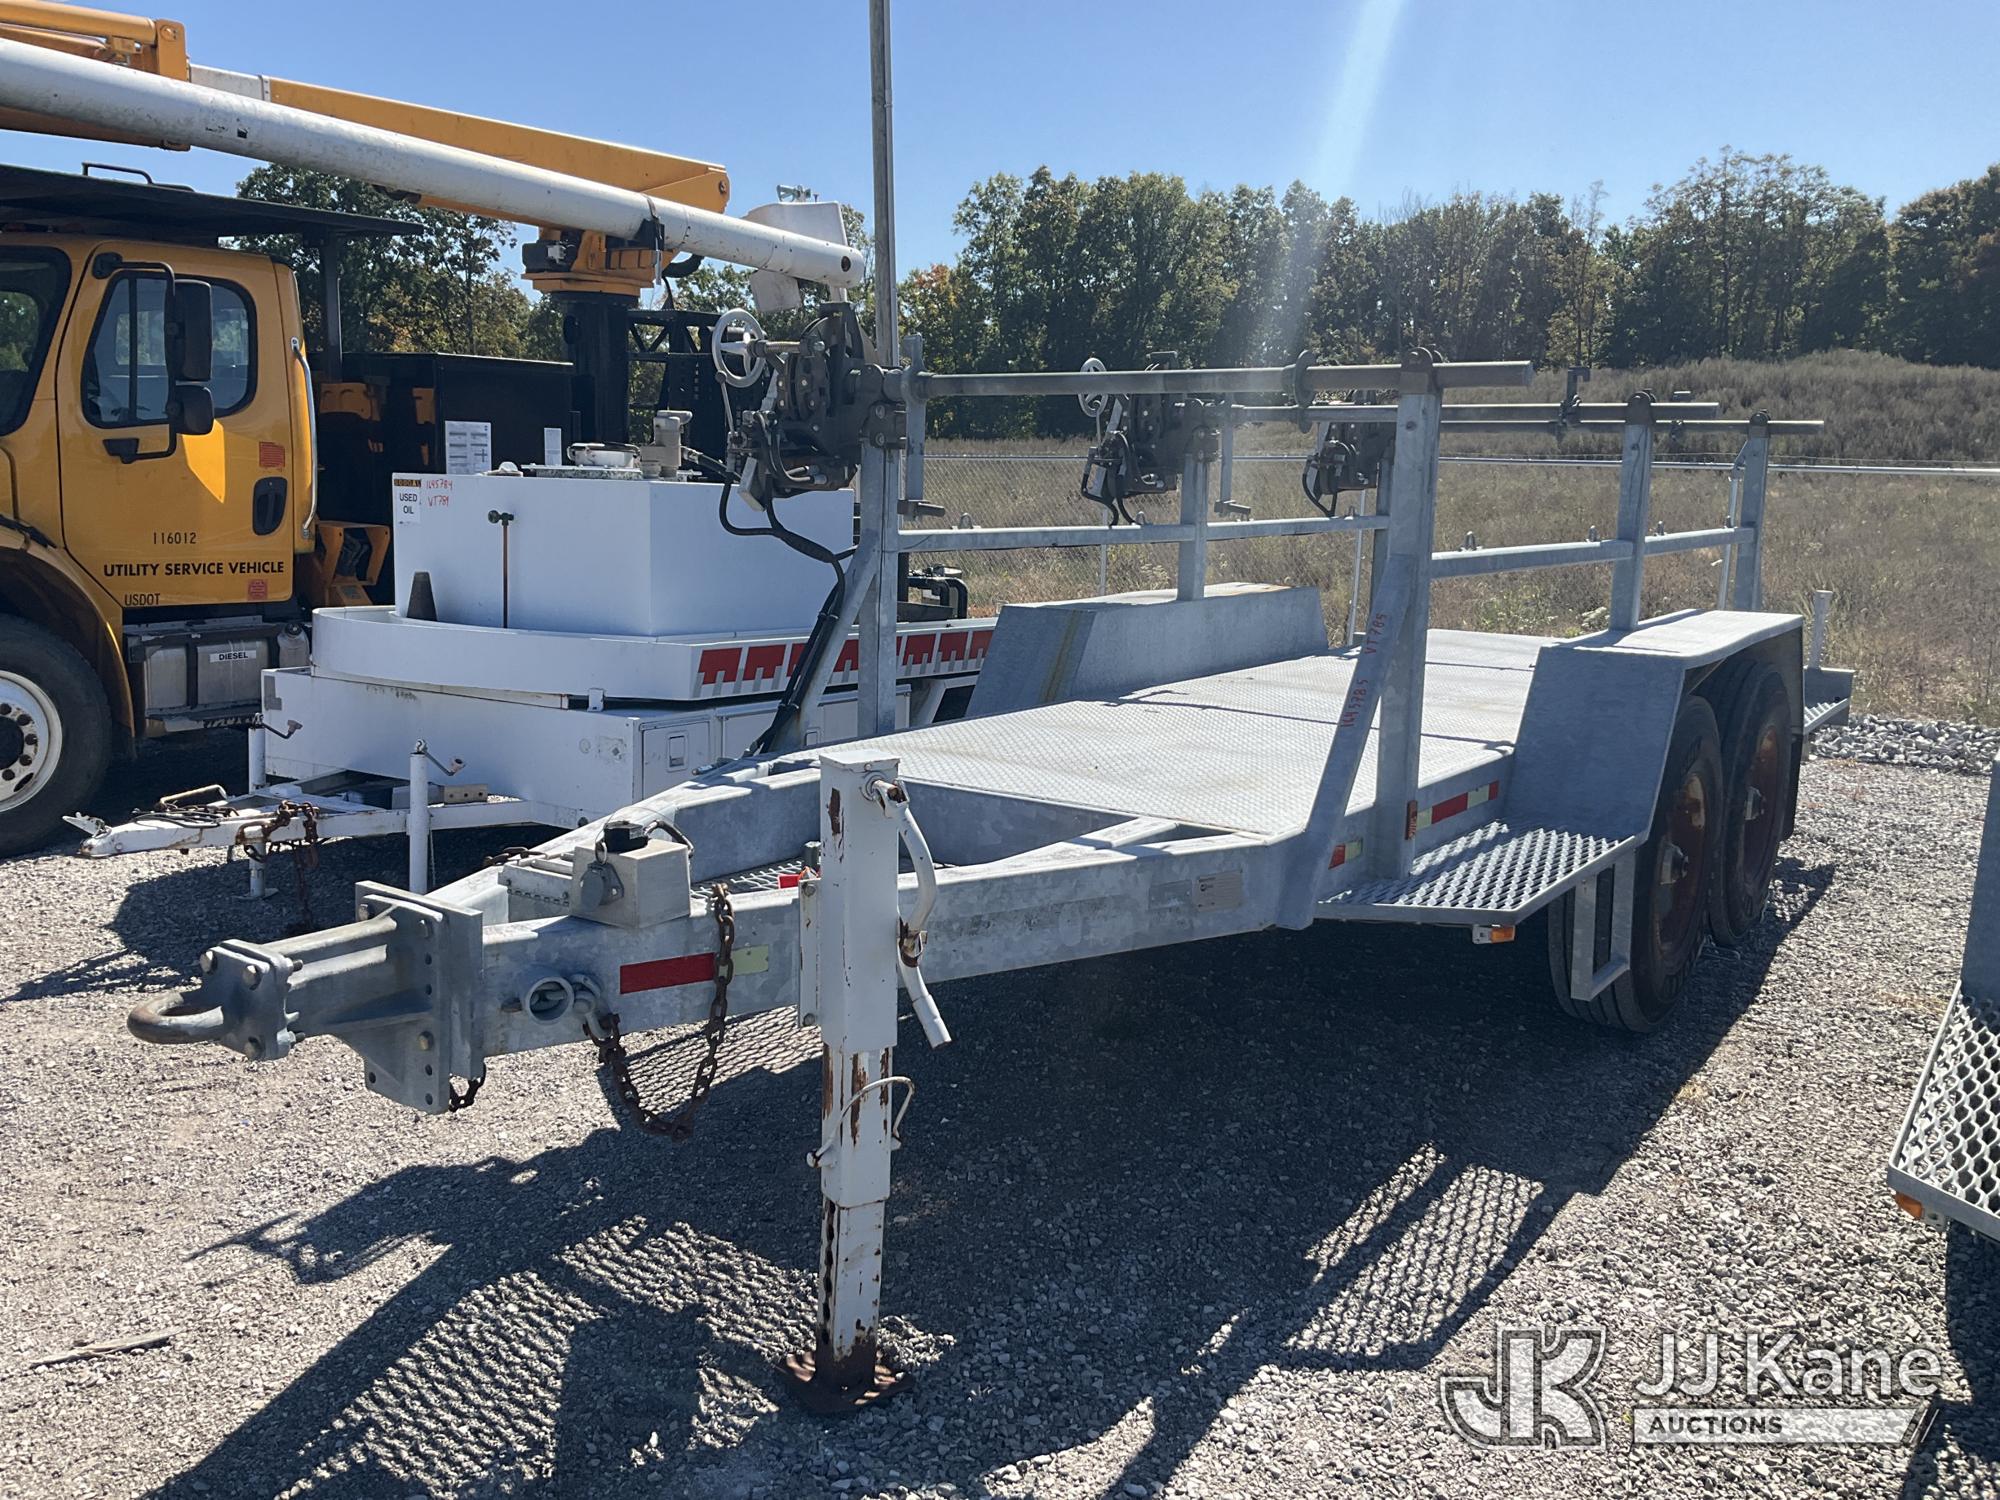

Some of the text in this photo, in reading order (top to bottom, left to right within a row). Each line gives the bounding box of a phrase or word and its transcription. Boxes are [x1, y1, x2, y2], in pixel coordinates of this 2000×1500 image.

[399, 493, 418, 502] USED
[403, 505, 414, 514] OIL
[153, 532, 197, 544] 116012
[103, 561, 284, 577] UTILITY SERVICE VEHICLE
[124, 593, 161, 606] USDOT
[218, 651, 248, 661] DIESEL
